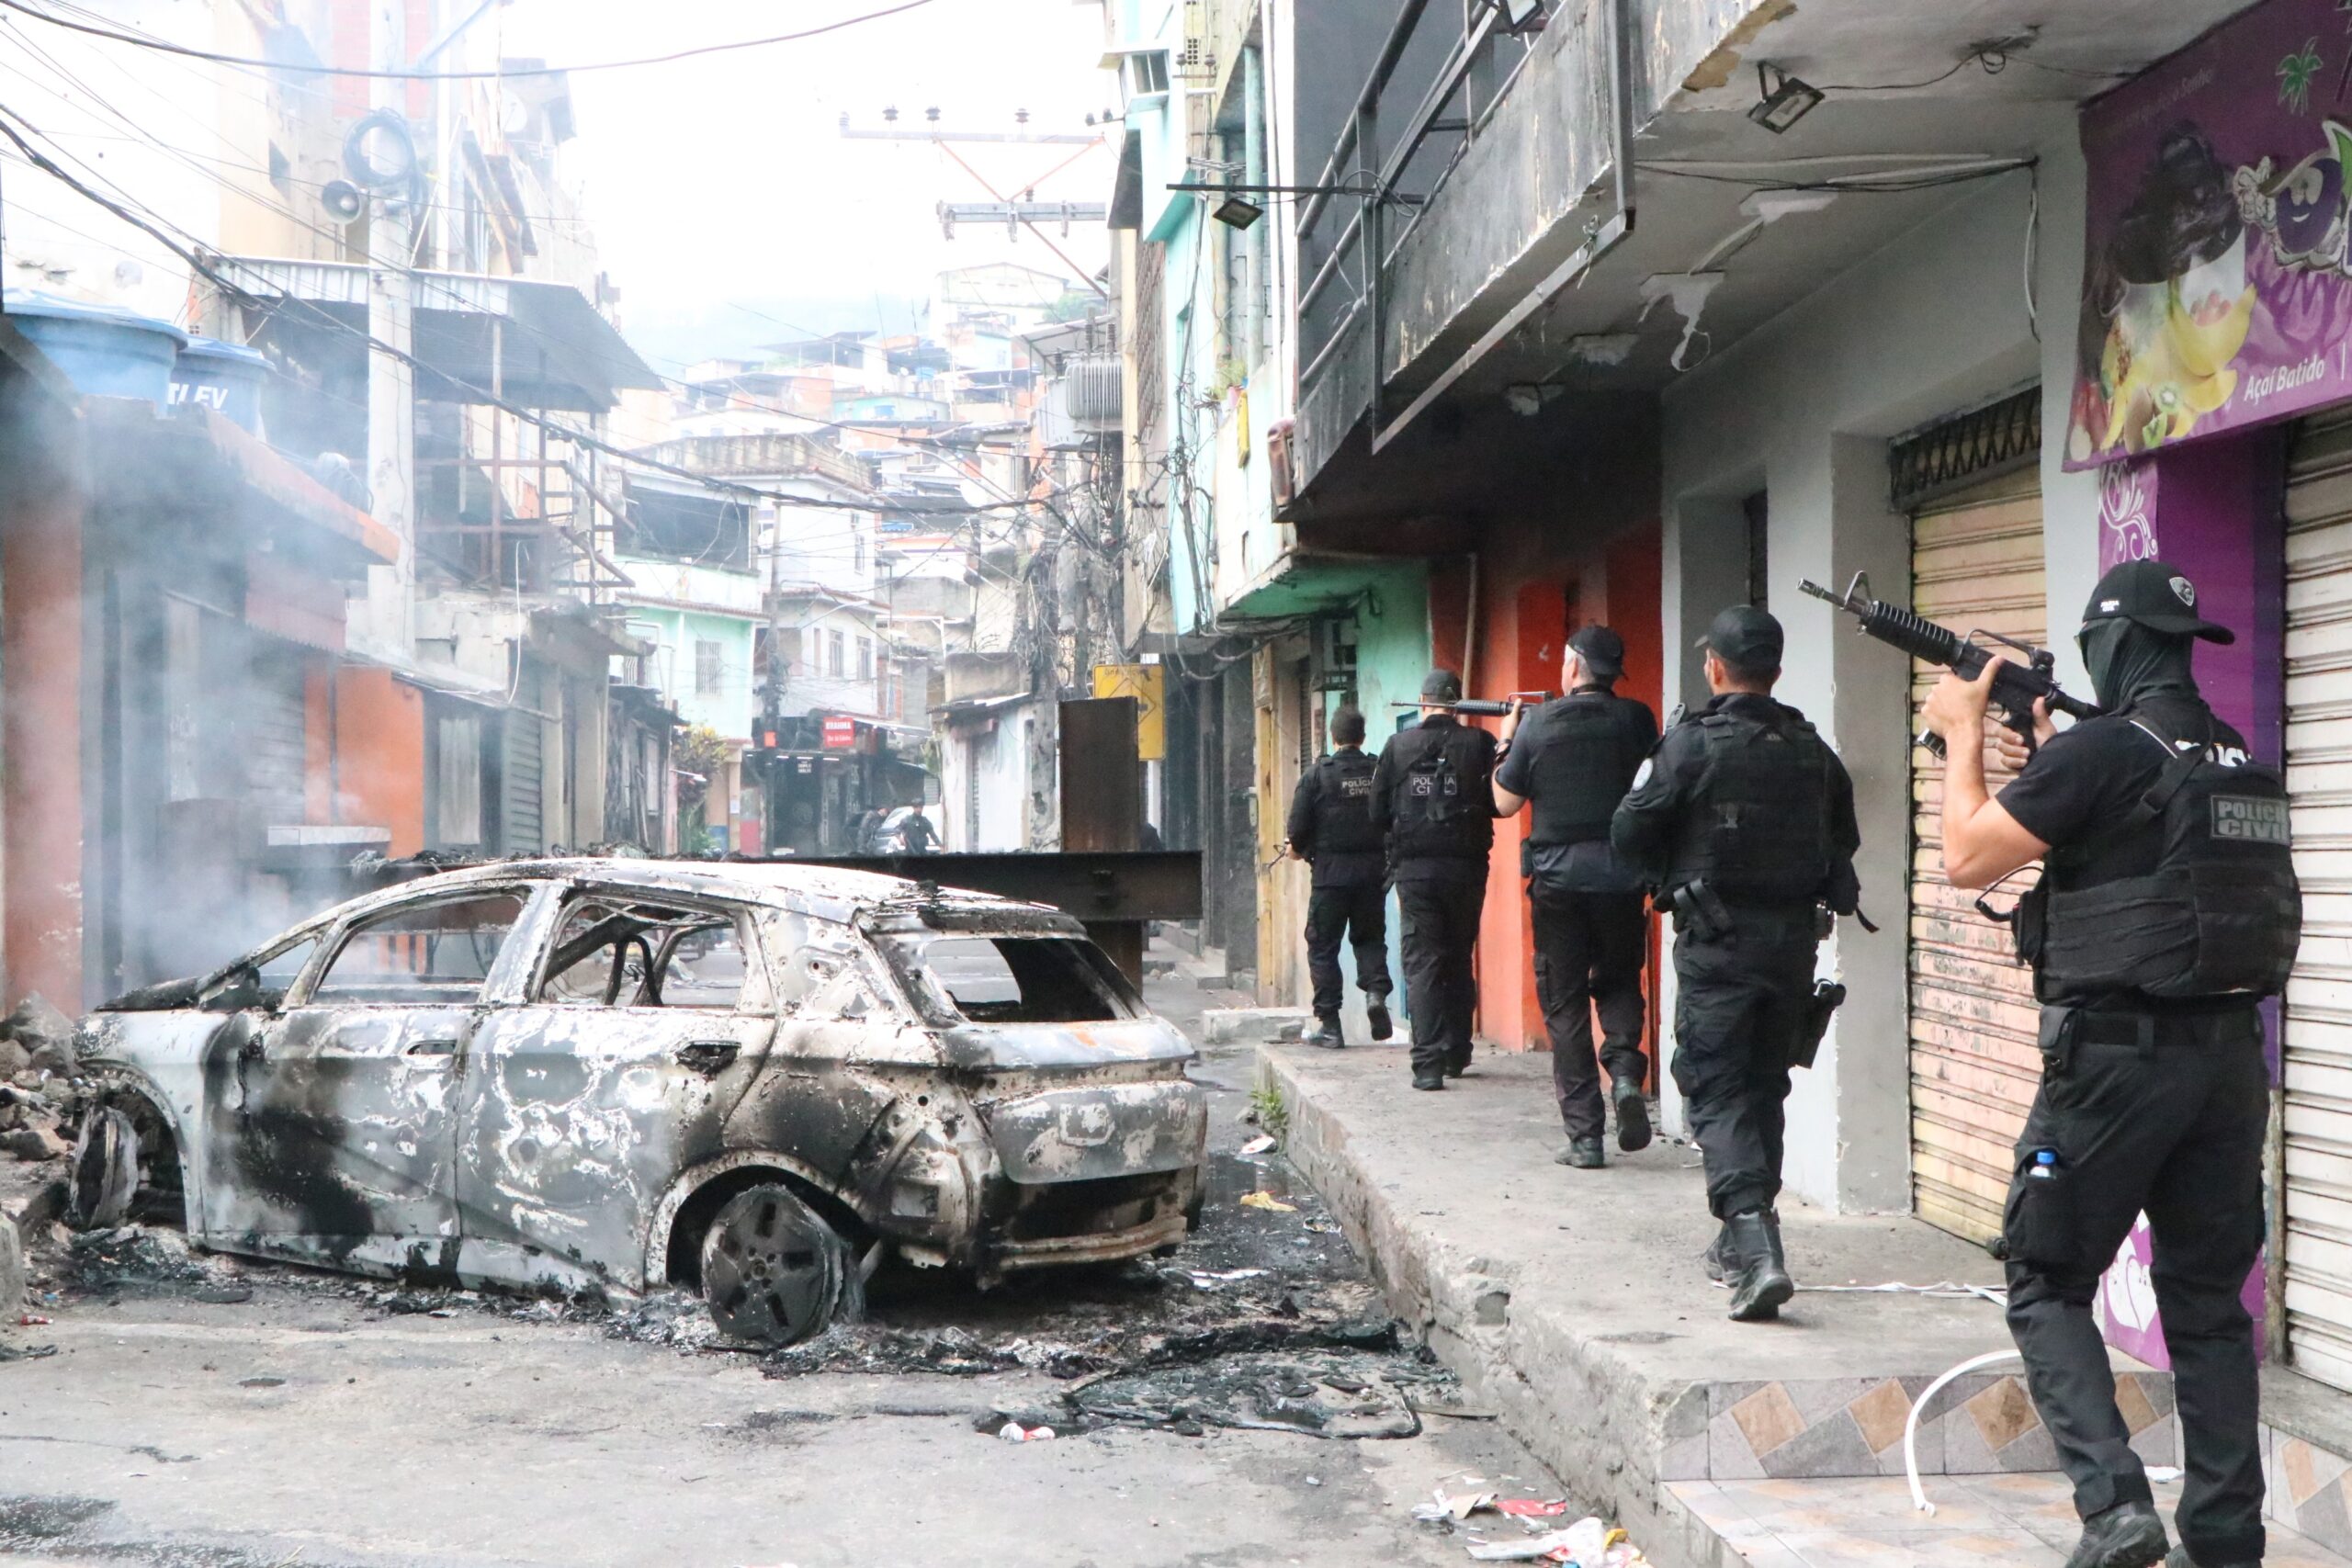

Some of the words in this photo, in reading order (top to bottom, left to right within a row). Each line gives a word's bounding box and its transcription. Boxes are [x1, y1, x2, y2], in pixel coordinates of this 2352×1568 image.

[2244, 367, 2277, 405] Açaí
[2276, 354, 2324, 392] Batido
[1341, 778, 1372, 789] POLÍCI
[1412, 776, 1455, 786] POLIA
[1416, 785, 1452, 795] CIL
